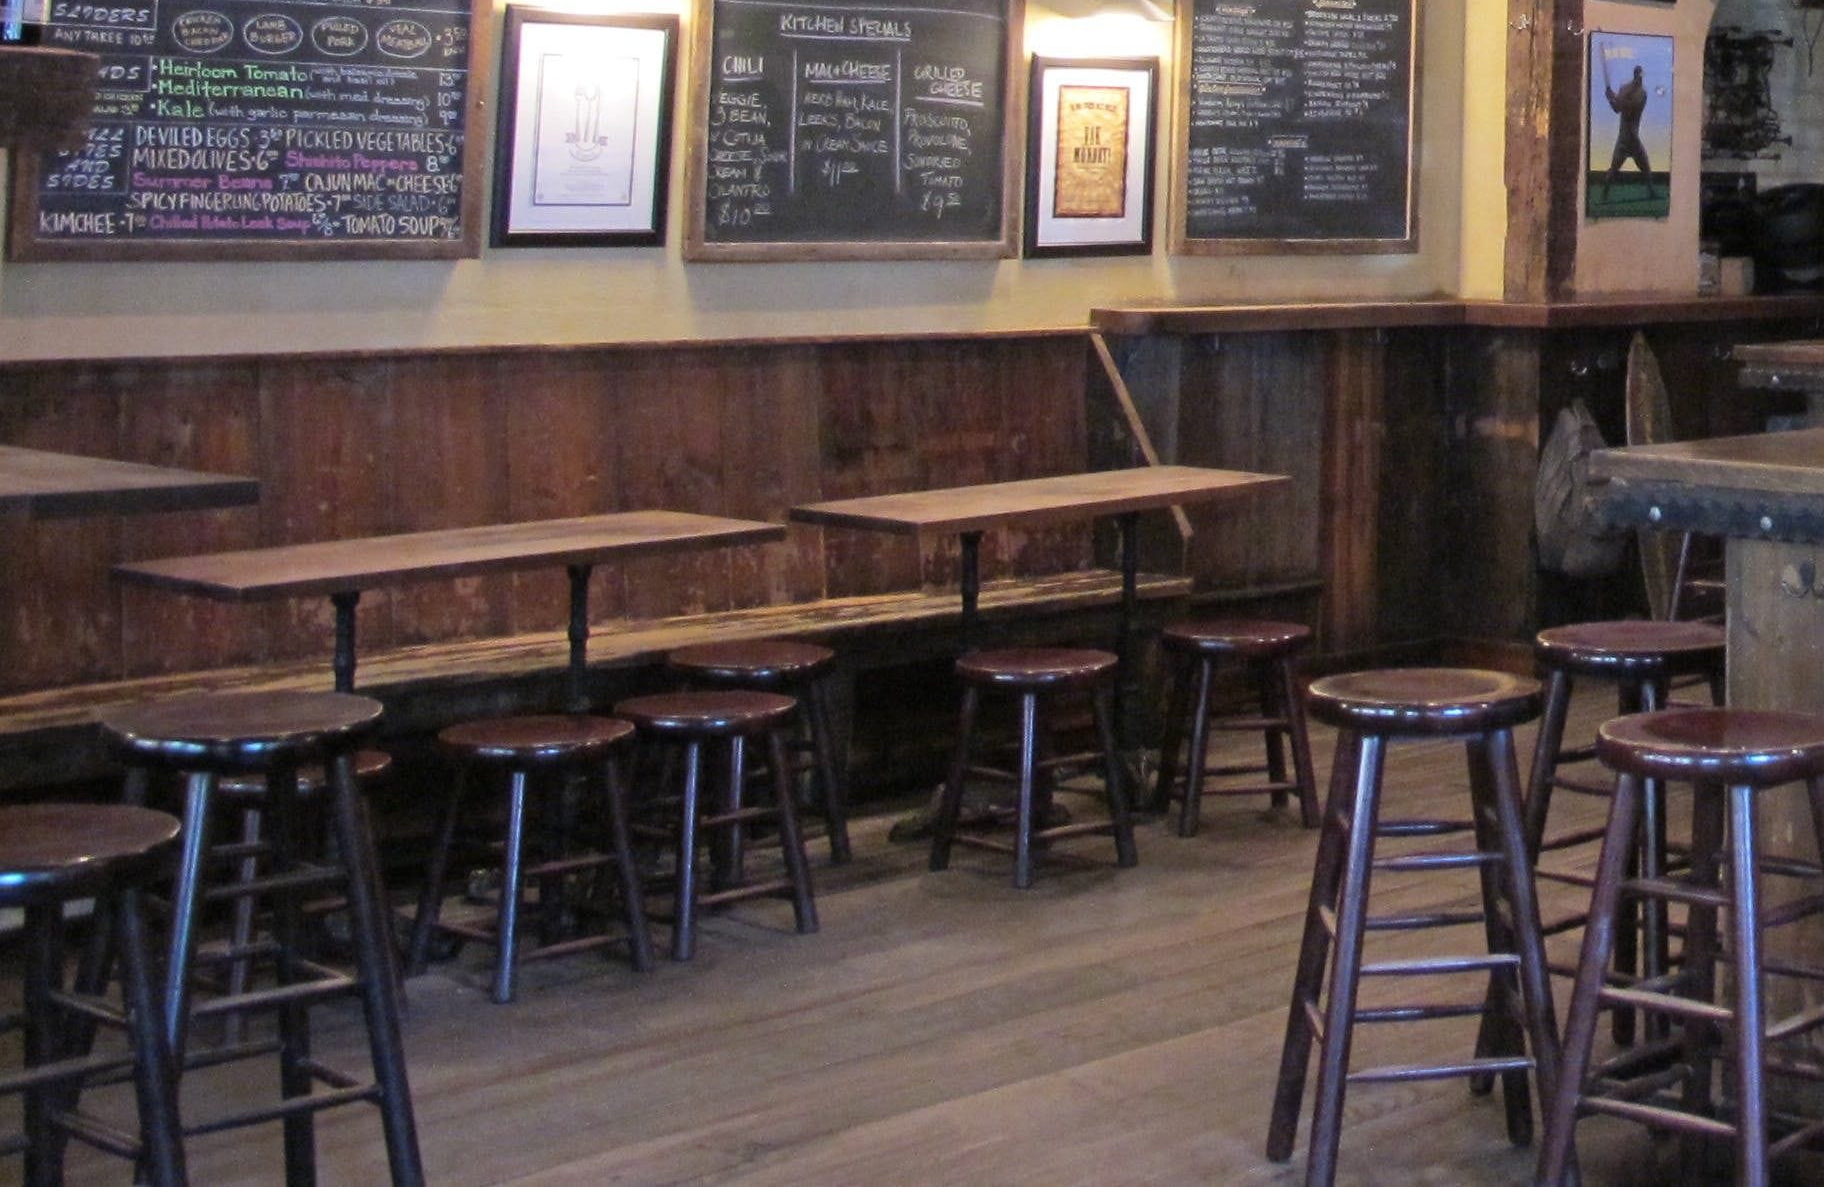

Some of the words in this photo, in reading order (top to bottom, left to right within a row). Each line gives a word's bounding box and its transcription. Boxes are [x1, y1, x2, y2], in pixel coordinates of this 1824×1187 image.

[54, 3, 149, 23] SLIDERS
[781, 14, 844, 34] KITCHEN
[160, 59, 237, 79] Heirloom
[244, 64, 307, 82] Tomato
[723, 56, 763, 74] CHILI
[159, 78, 303, 100] Mediterranean
[157, 99, 205, 119] Kale
[136, 125, 203, 147] DEVILED
[207, 126, 250, 148] EGGS
[286, 128, 352, 150] PICKLED
[357, 131, 444, 154] VEGETABLES
[133, 148, 189, 169] MIXED
[191, 149, 251, 172] OLIVES
[47, 174, 115, 190] SIDES
[305, 173, 352, 192] CAJUN
[354, 173, 385, 192] MAC
[126, 192, 176, 210] SPICY
[38, 211, 115, 234] KIMCHEE
[342, 213, 396, 235] TOMATO
[399, 215, 441, 237] SOUP
